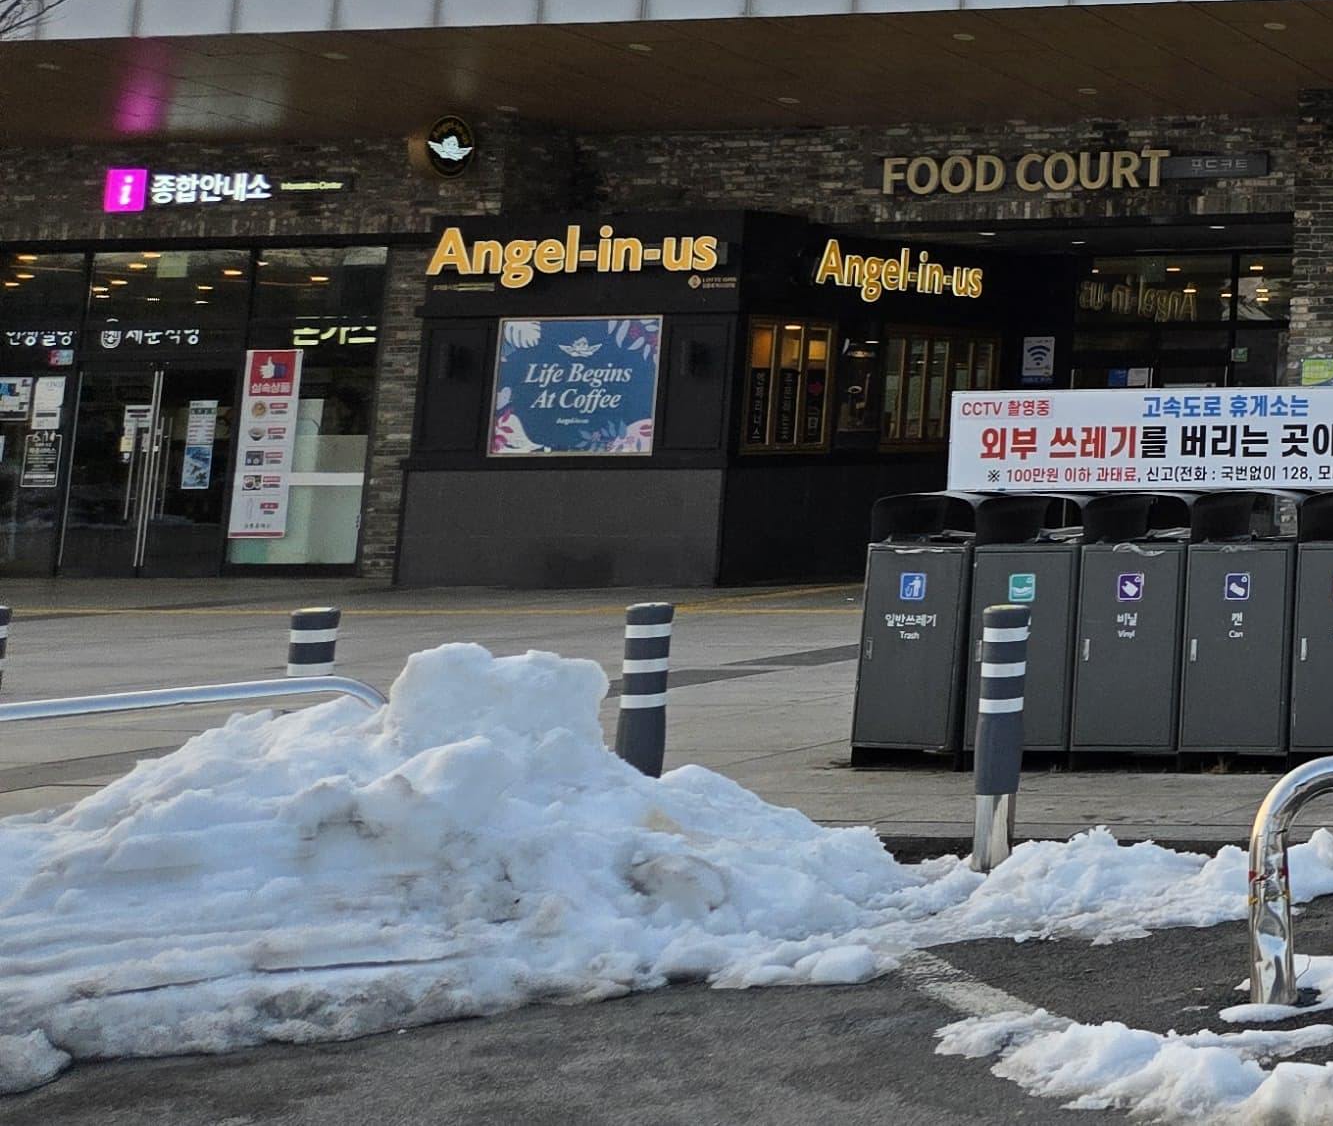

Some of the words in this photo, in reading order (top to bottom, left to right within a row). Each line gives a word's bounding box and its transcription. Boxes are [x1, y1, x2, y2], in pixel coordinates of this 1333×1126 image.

[882, 154, 1006, 195] FOOD
[1015, 148, 1170, 191] COURT
[151, 173, 272, 204] 종합안내소
[425, 225, 718, 288] Angel-in-us
[815, 238, 983, 303] Angel-in-us
[524, 364, 564, 388] Life
[566, 363, 633, 387] Begins
[530, 389, 557, 409] At
[559, 387, 622, 414] Coffee
[961, 401, 1003, 416] CCTV
[1007, 399, 1050, 417] 촬영중
[1142, 395, 1222, 418] 고속도로
[1229, 394, 1309, 419] 휴게소는
[980, 427, 1038, 461] 외부
[1049, 425, 1168, 460] 쓰레기를
[1180, 424, 1269, 459] 버리는
[1006, 467, 1059, 483] 100만원
[1064, 467, 1091, 482] 이하
[1096, 466, 1141, 483] 과태료,
[1146, 465, 1208, 482] 신고(전화
[1221, 465, 1276, 481] 국번없이
[1282, 465, 1313, 482] 128,
[884, 613, 937, 627] 일반쓰레기
[1116, 612, 1138, 626] 비닐
[1231, 612, 1243, 626] 캔
[899, 630, 919, 640] Trash
[1117, 629, 1135, 640] Vinyl
[1228, 629, 1244, 639] Can
